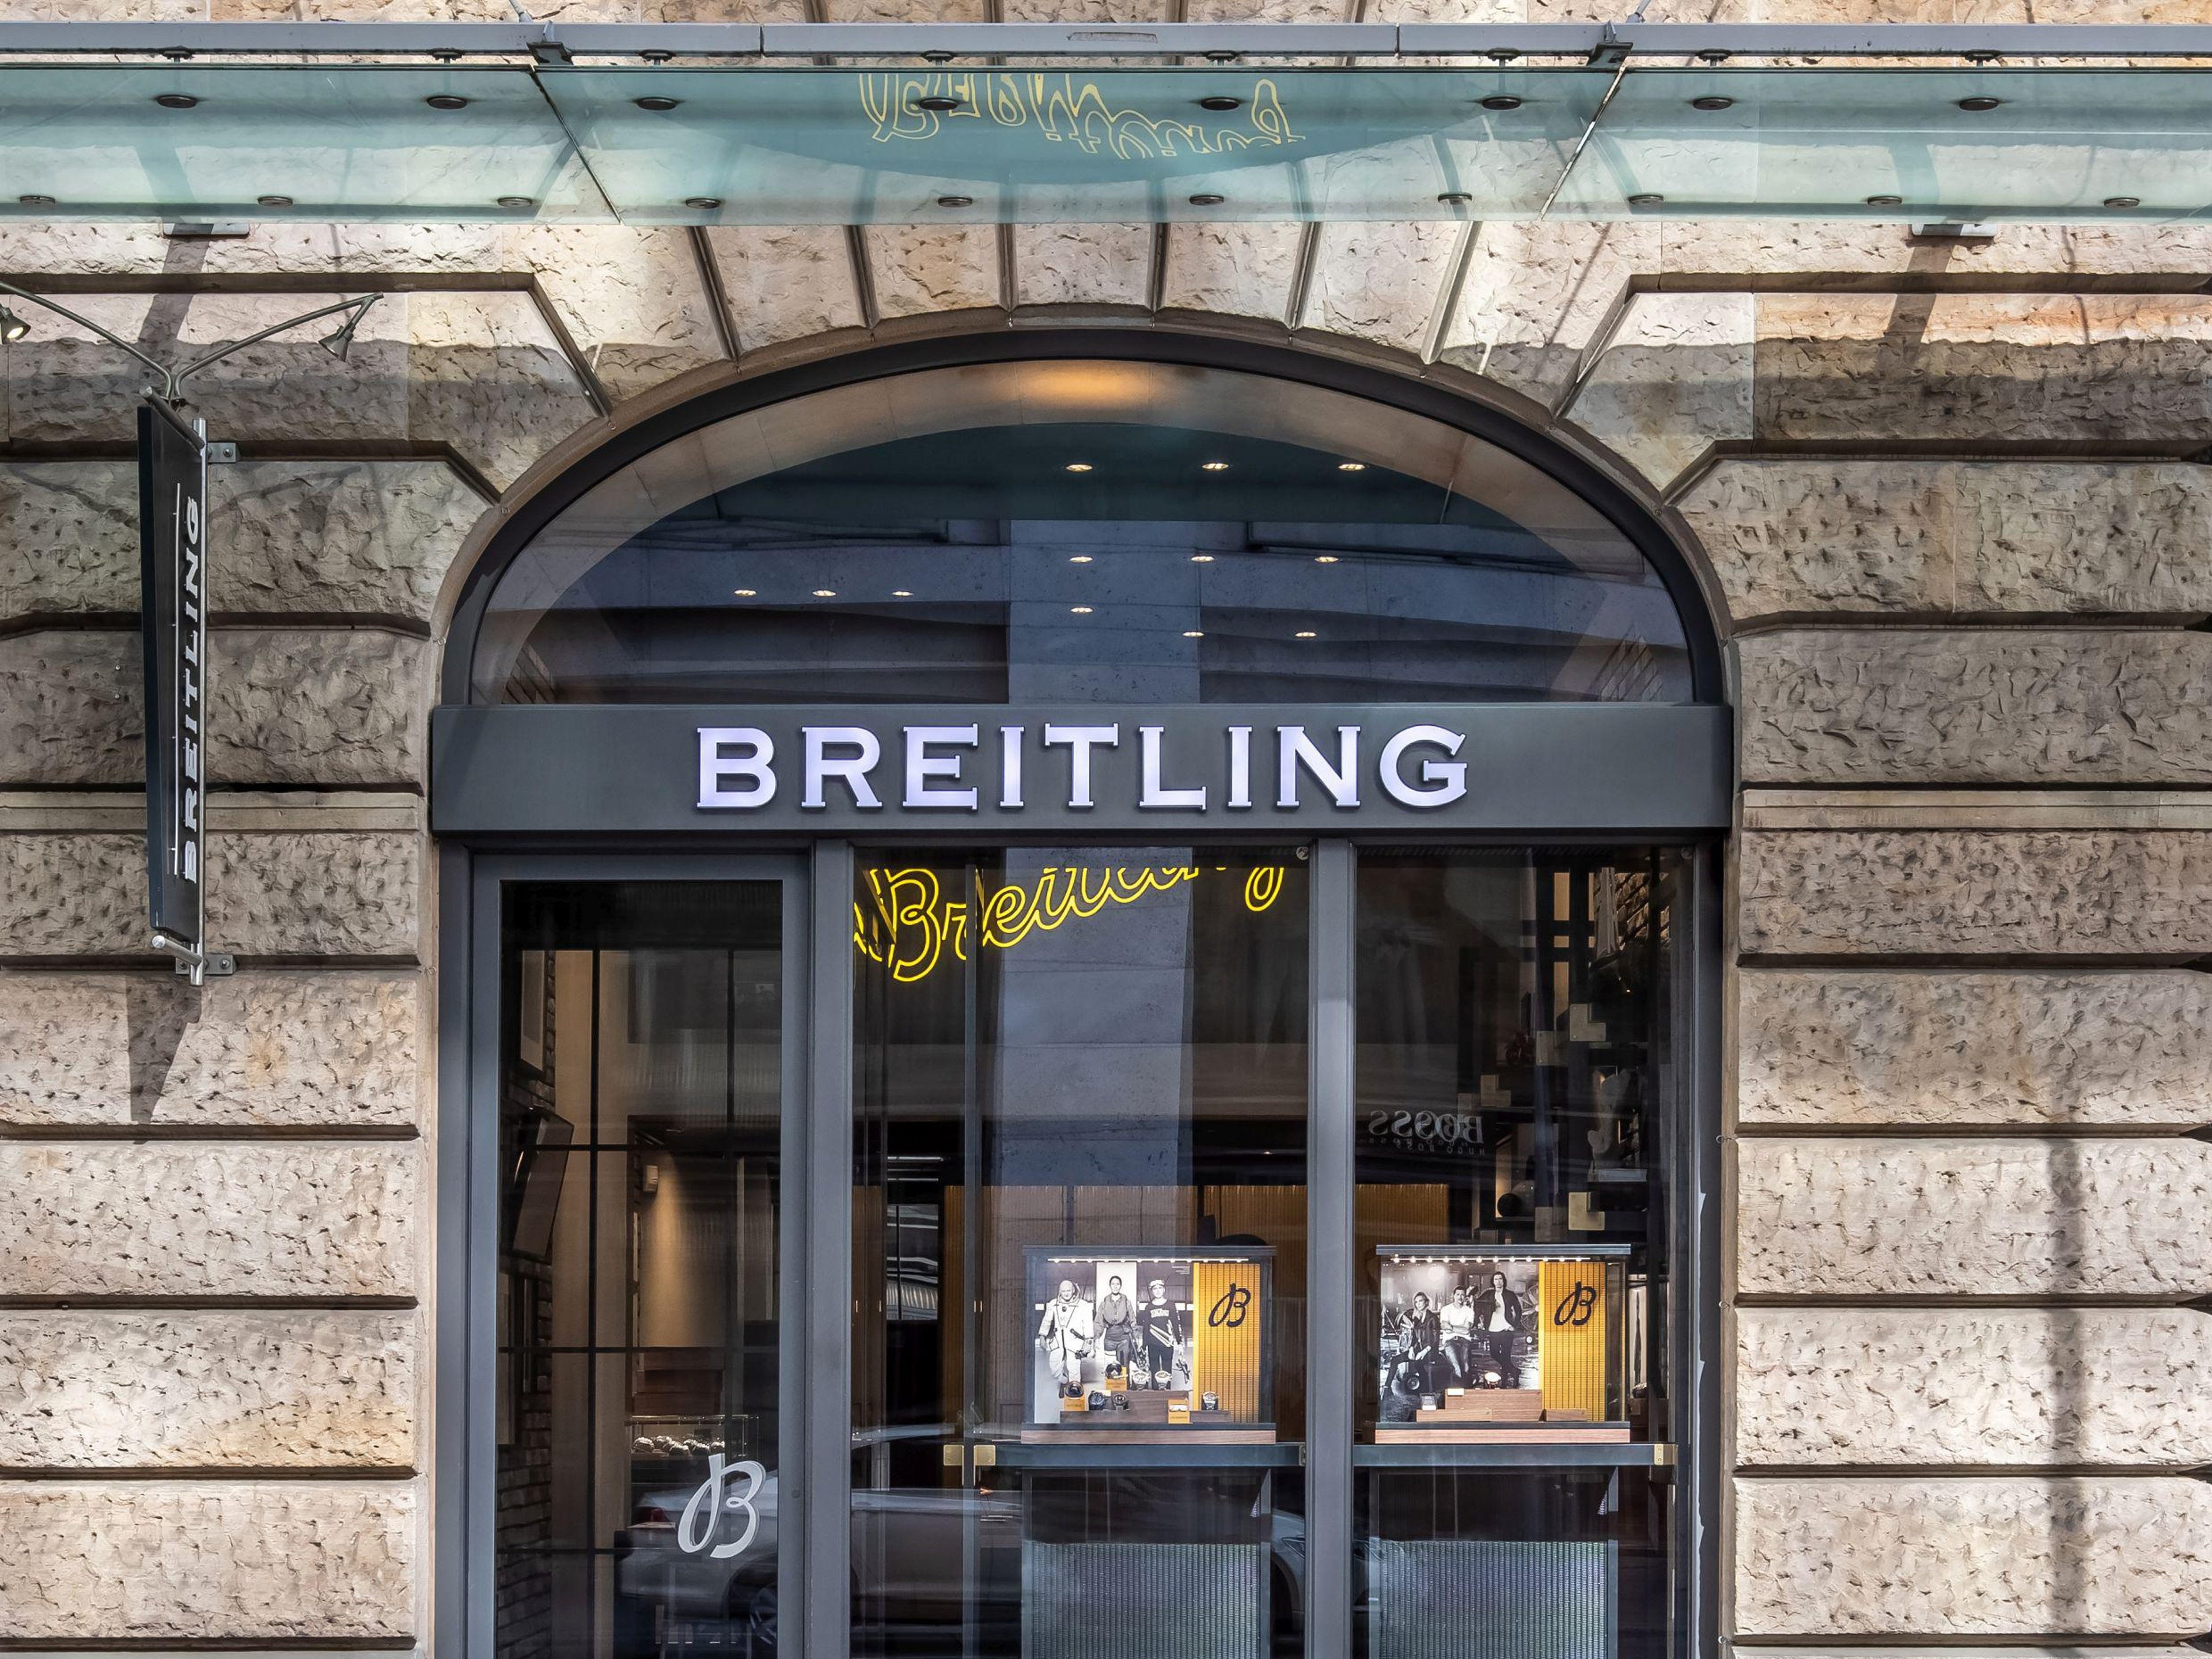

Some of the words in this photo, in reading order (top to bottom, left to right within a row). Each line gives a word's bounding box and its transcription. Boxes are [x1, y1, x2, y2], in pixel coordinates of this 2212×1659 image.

[184, 495, 200, 885] BREITLING
[697, 723, 1467, 810] BREITLING
[854, 867, 1285, 982] Breig
